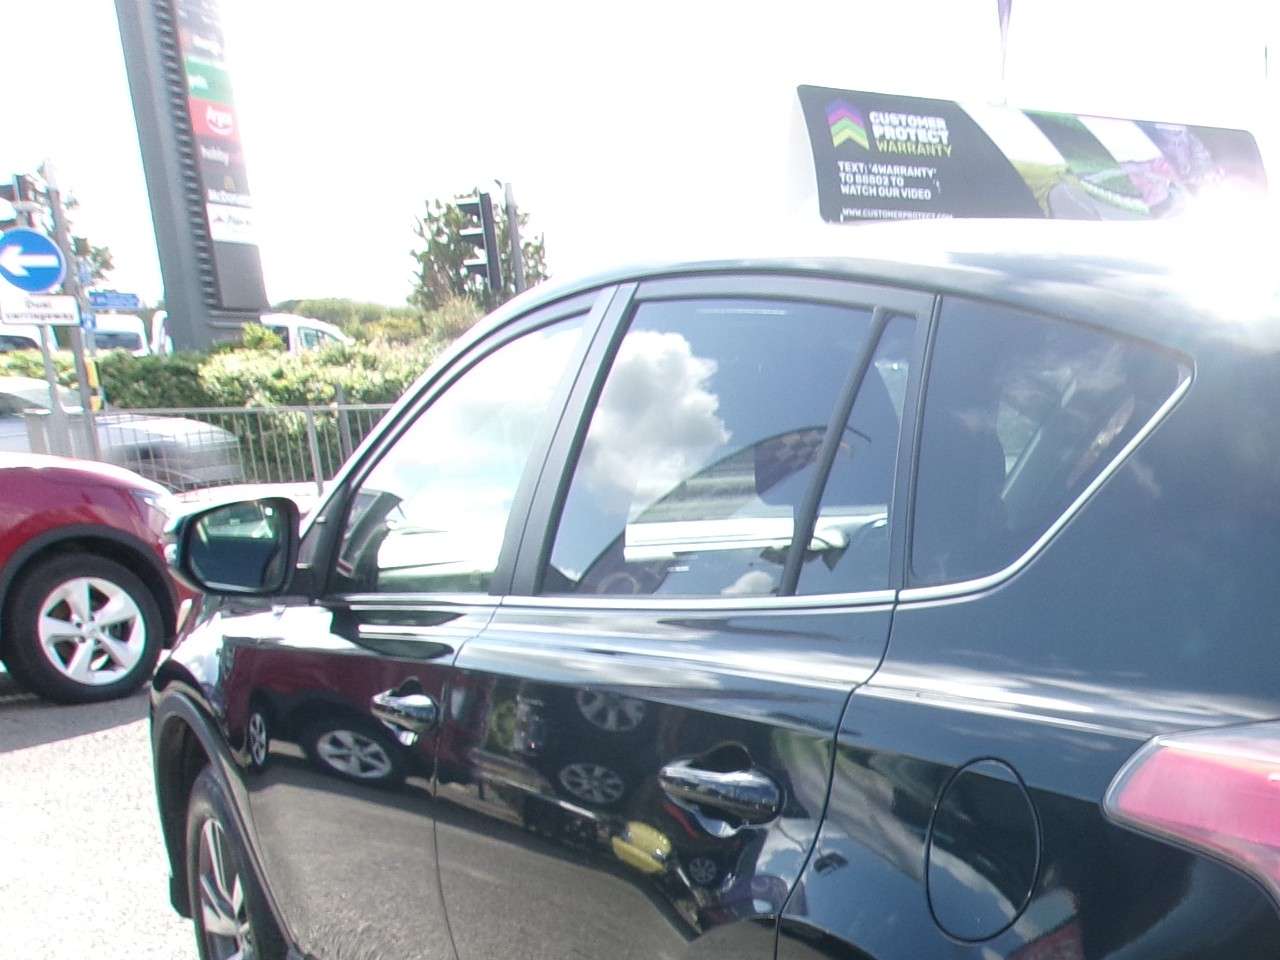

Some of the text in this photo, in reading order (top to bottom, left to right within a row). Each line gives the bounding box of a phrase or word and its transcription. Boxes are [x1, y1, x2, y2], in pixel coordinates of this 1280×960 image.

[869, 111, 947, 131] CUSTOMER
[872, 123, 949, 145] PROTECT
[876, 139, 952, 158] WARRANTY
[839, 172, 854, 184] TO
[891, 175, 905, 187] TO
[840, 183, 932, 201] WATCH OUR VIDEO
